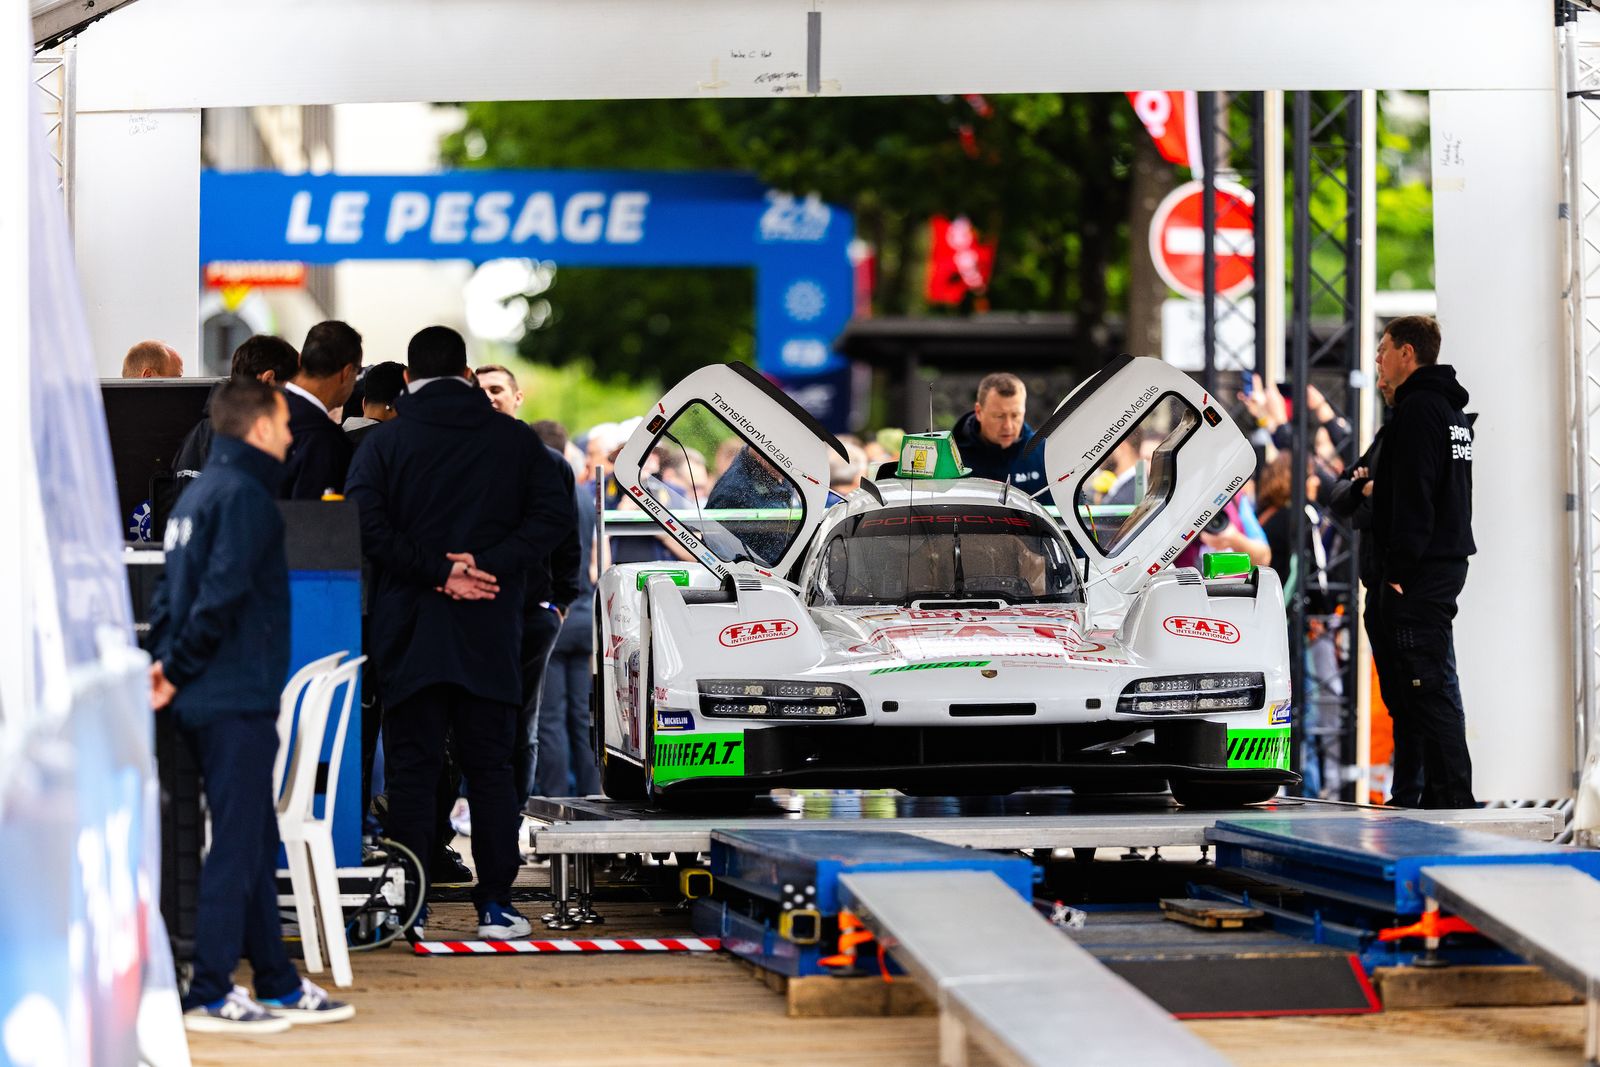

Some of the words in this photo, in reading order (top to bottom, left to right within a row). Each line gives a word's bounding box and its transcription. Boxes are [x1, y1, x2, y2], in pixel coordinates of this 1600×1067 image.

[285, 191, 370, 244] LE
[385, 191, 650, 244] PESAGE
[711, 392, 793, 469] TransitionMetals
[1082, 385, 1159, 461] TransitionMetals
[1225, 476, 1243, 493] NICO
[643, 498, 662, 516] NEEL
[861, 514, 1032, 529] PORSCHE
[1193, 510, 1212, 528] NICO
[679, 531, 698, 549] NICO
[1160, 545, 1181, 563] NEEL
[715, 564, 730, 578] NIC
[731, 631, 787, 645] INTERNATIONAL
[1175, 628, 1231, 641] INTERNATIONAL
[664, 716, 689, 725] MICHELIN
